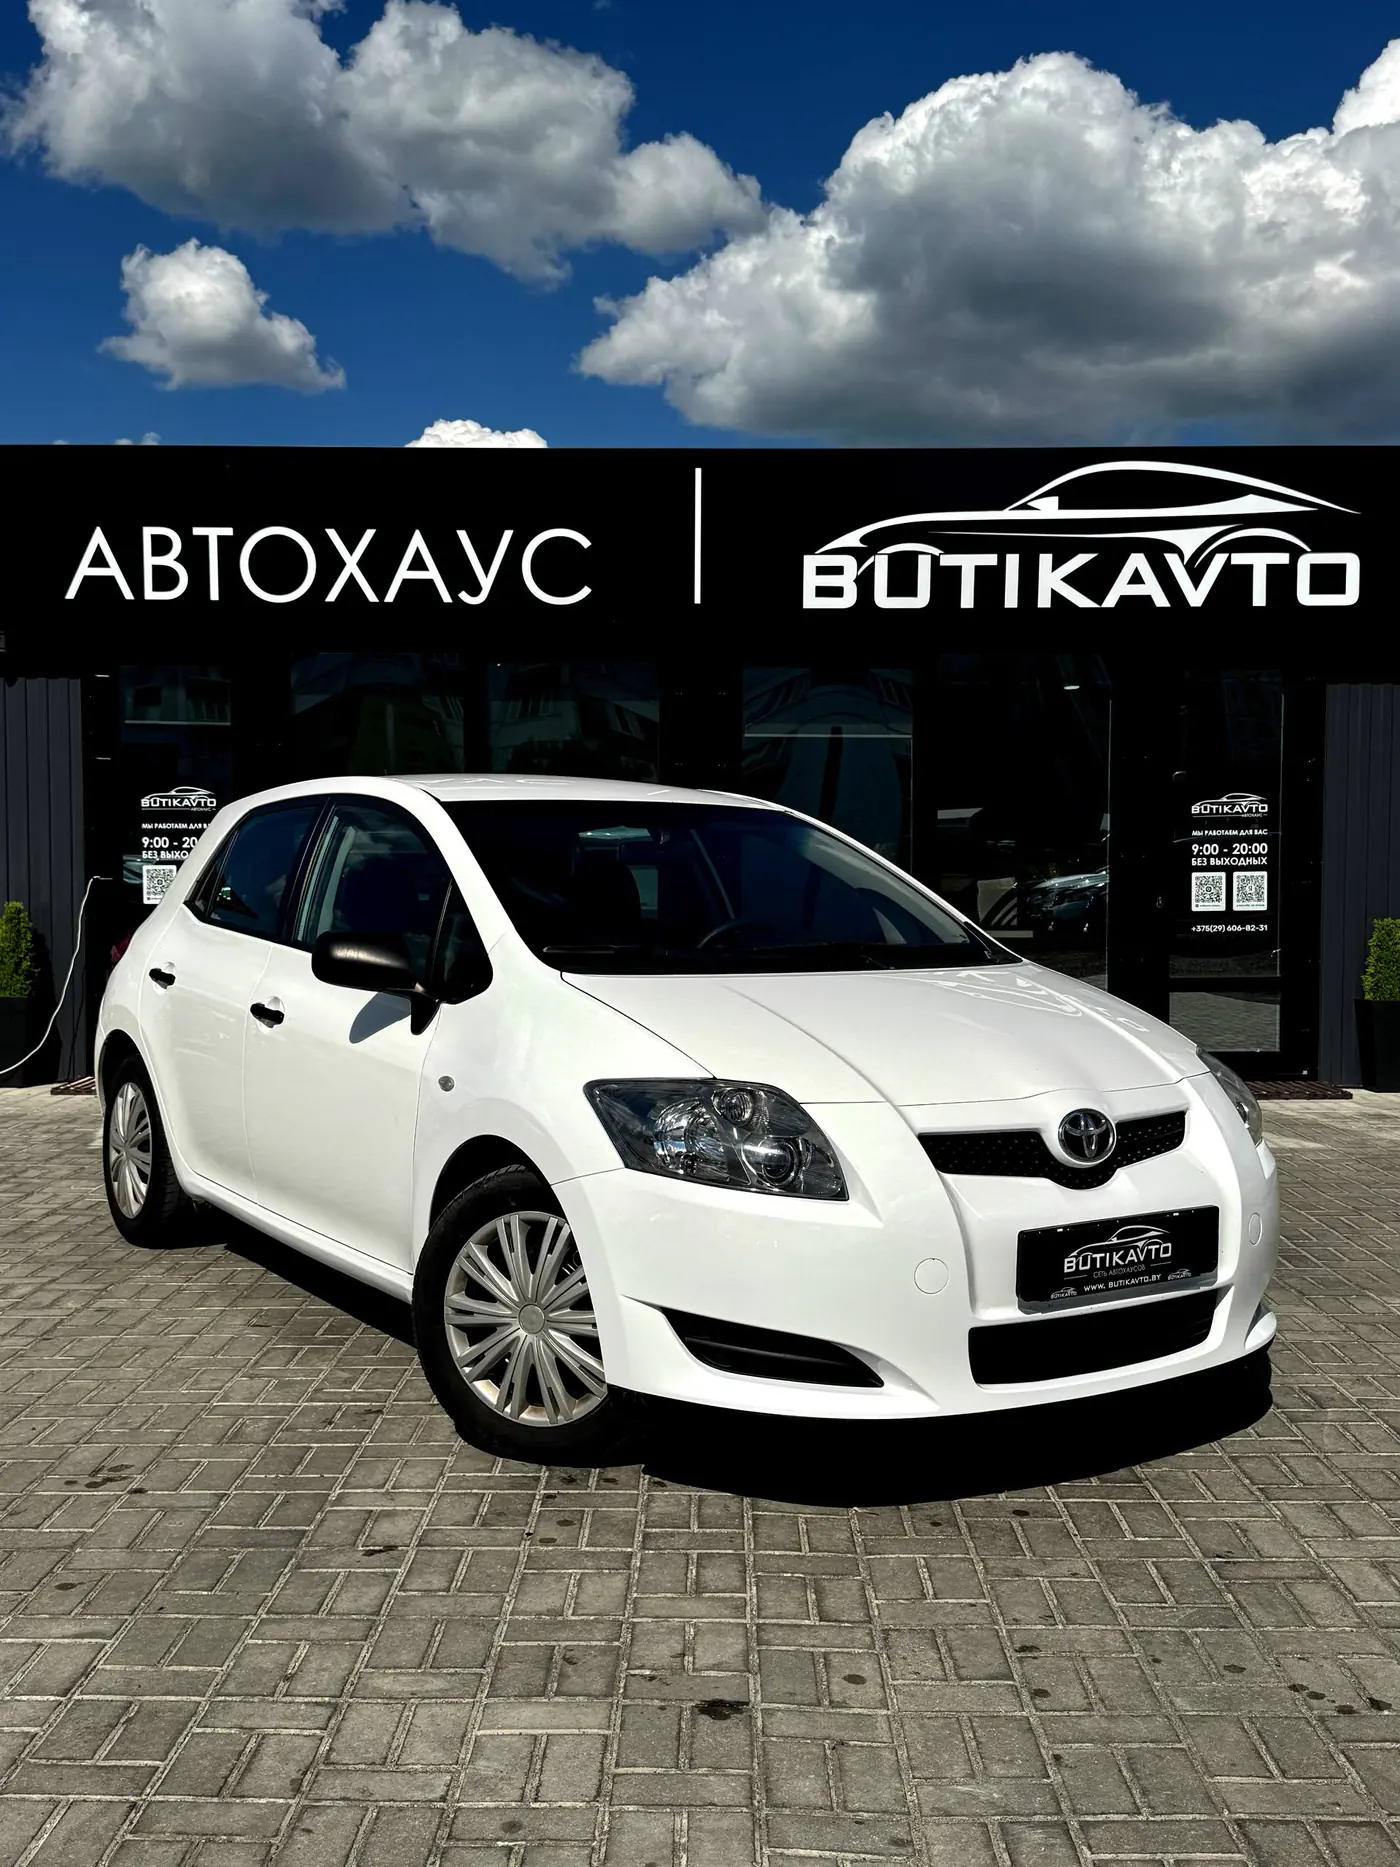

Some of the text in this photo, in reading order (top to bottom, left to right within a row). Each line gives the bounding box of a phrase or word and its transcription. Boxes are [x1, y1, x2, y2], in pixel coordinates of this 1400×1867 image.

[65, 526, 593, 606] АВТОХАУС
[802, 551, 1361, 609] BUTIKAVTO
[141, 798, 217, 807] BUTIKAVTO
[1191, 804, 1268, 814] BUTIKAVTO
[142, 837, 170, 848] 9:00
[182, 837, 198, 848] 20
[1192, 844, 1219, 855] 9:00
[1232, 843, 1268, 854] 20:00
[142, 851, 189, 859] БЕЗ ВЫХО
[1191, 857, 1268, 866] БЕЗ ВЫХОДНЫХ
[1191, 924, 1268, 933] +375(29) 606-82-31
[1063, 1243, 1172, 1273] BUTIKAVTO
[1108, 1274, 1162, 1288] BUTIKAVTO.BY
